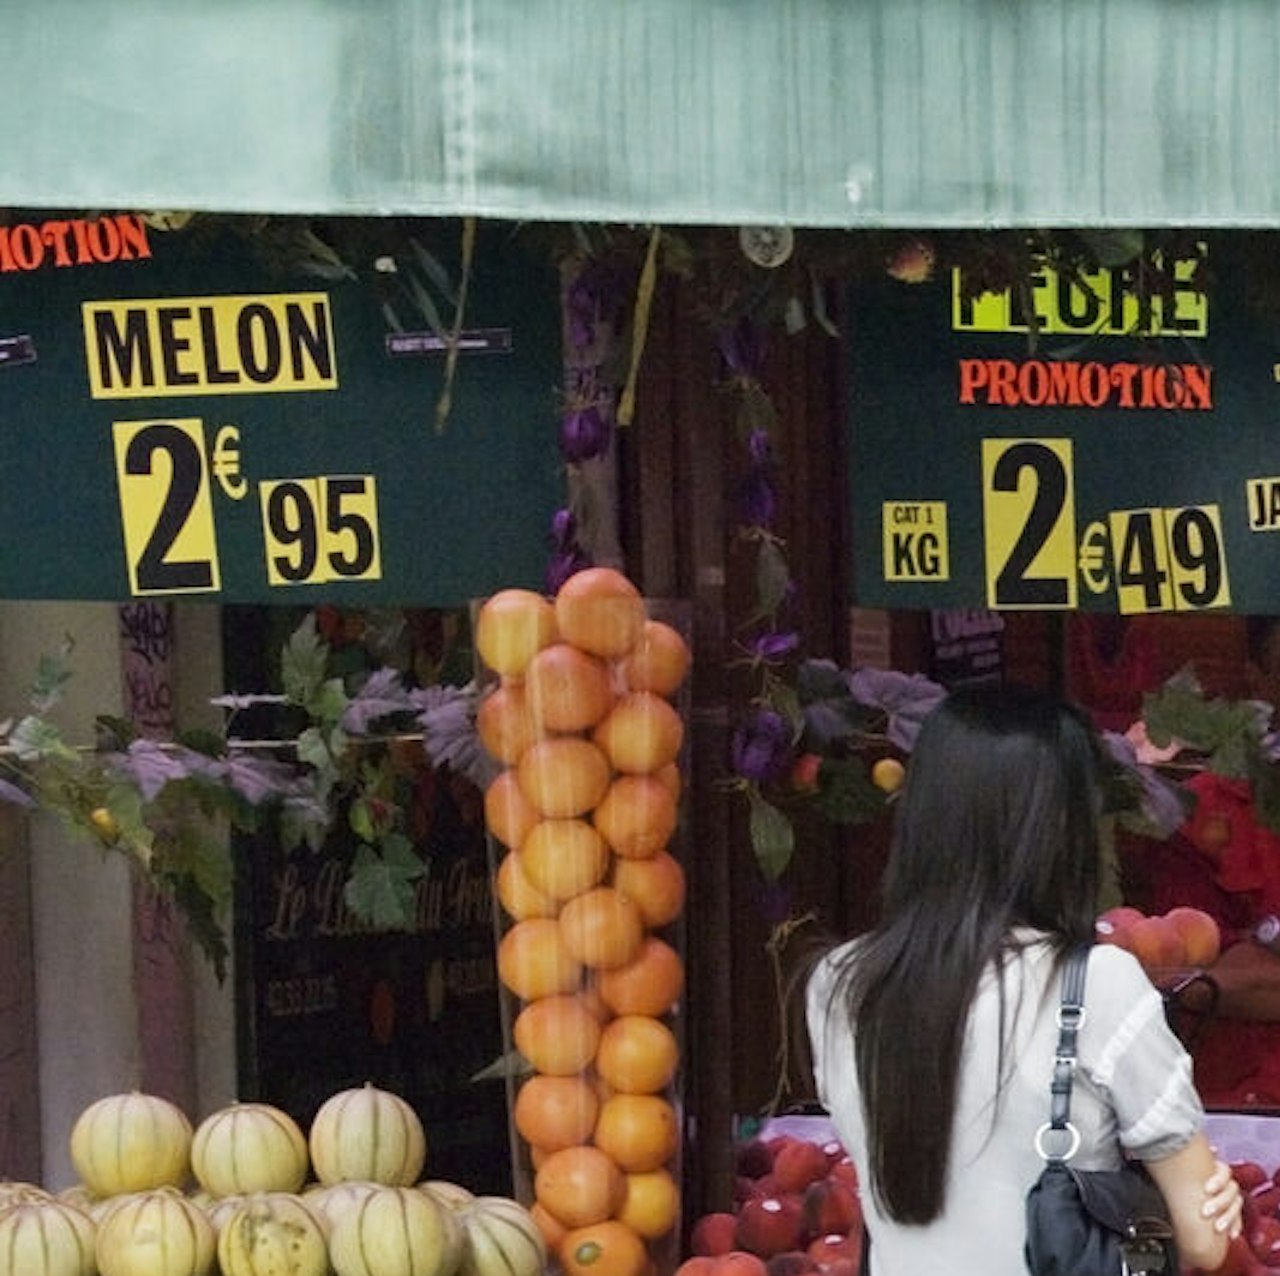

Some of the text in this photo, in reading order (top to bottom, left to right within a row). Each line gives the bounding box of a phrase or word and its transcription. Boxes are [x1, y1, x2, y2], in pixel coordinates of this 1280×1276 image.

[93, 301, 332, 389] MELON
[960, 359, 1212, 409] PROMOTION
[893, 507, 933, 524] CAT 1
[893, 532, 940, 576] KG
